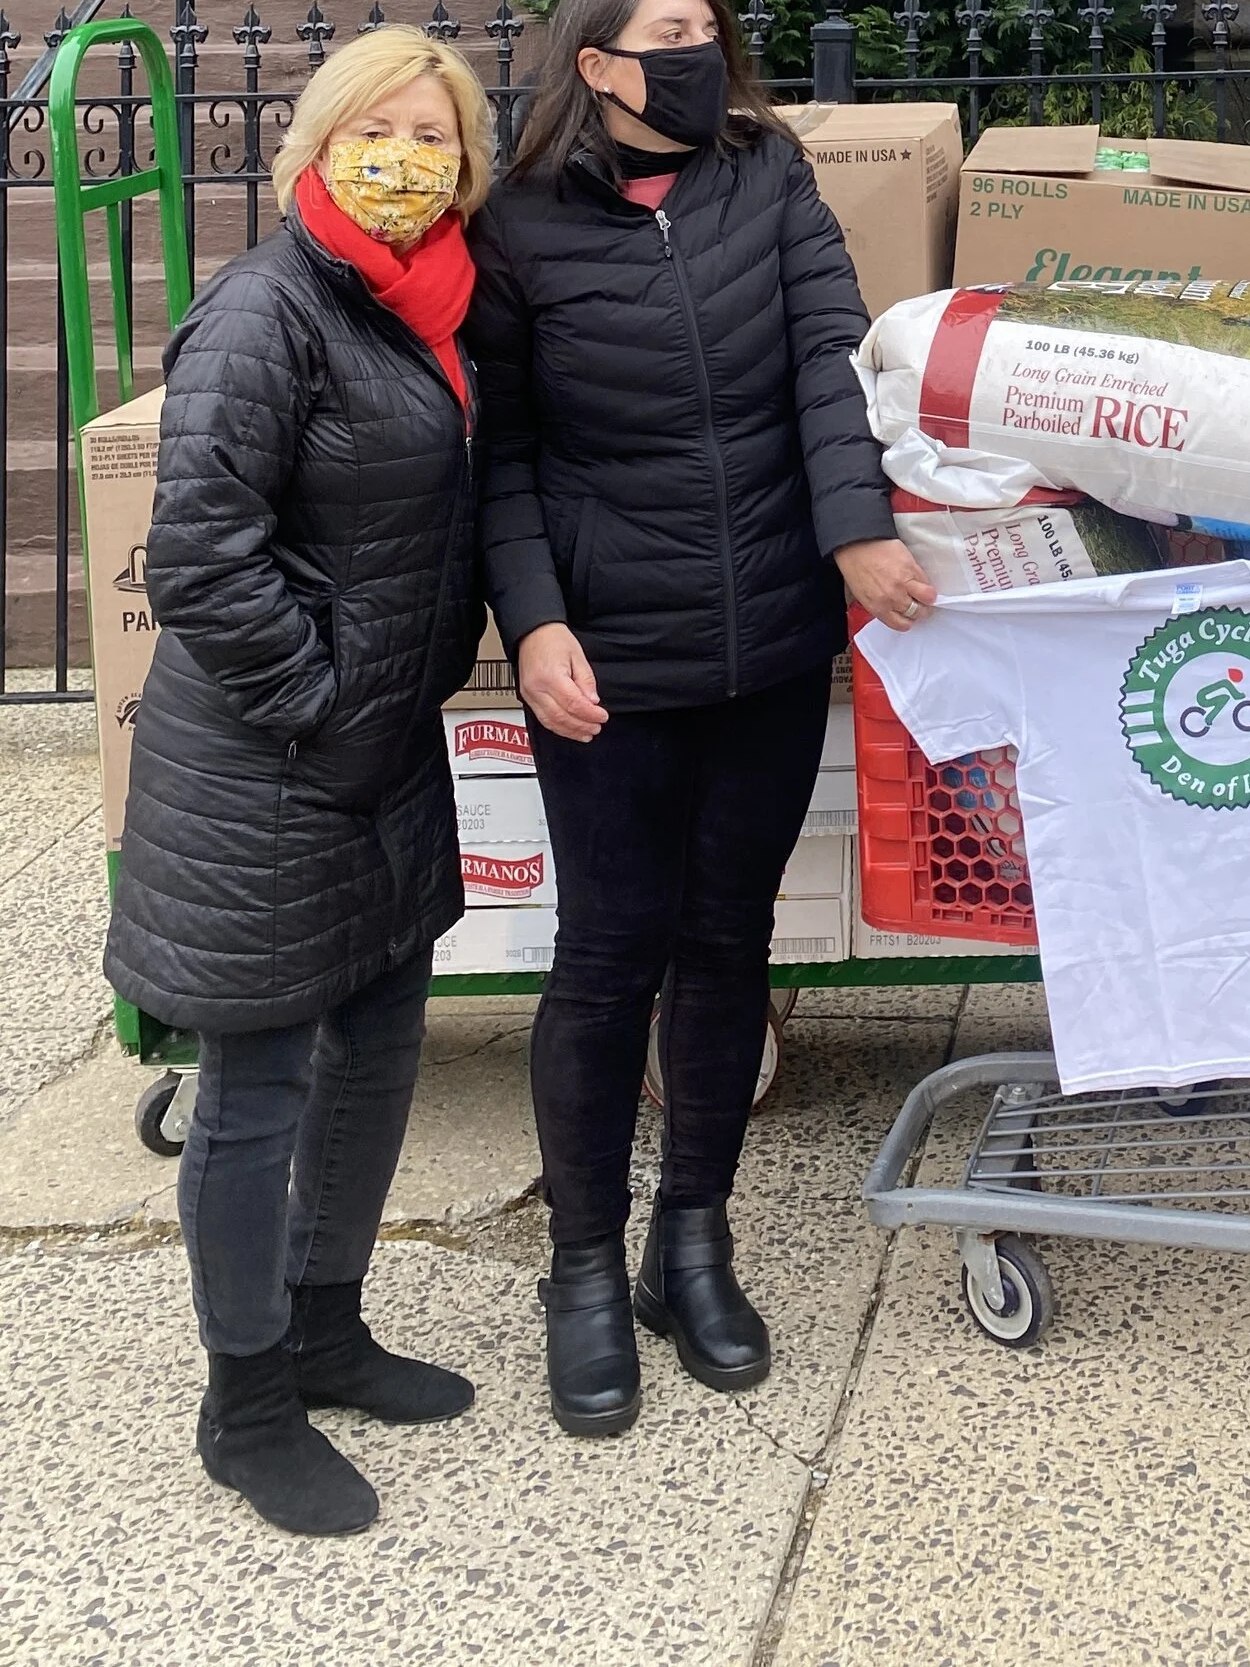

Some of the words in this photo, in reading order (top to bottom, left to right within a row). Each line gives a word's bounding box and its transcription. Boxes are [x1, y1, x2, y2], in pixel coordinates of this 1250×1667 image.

[817, 151, 852, 164] MADE
[855, 150, 868, 162] IN
[872, 149, 896, 162] USA
[972, 178, 996, 196] 96
[1001, 180, 1068, 200] ROLLS
[1123, 190, 1180, 209] MADE
[1187, 193, 1204, 210] IN
[970, 202, 981, 216] 2
[987, 203, 1024, 220] PLY
[1025, 340, 1050, 352] 100
[1054, 343, 1069, 354] LB
[1074, 346, 1115, 360] (45.36
[1118, 350, 1140, 364] kg)
[1012, 362, 1050, 385] Long
[1054, 366, 1095, 388] Grain
[1098, 371, 1169, 398] Enriched
[1005, 385, 1084, 415] Premium
[1001, 408, 1082, 438] Parboiled
[1089, 395, 1189, 452] RICE
[1005, 523, 1029, 559] Long
[1037, 515, 1054, 540] 100
[1048, 539, 1064, 558] LB
[1138, 631, 1196, 684] Tuga
[1160, 753, 1206, 794] Den
[1212, 778, 1239, 801] of
[456, 804, 491, 816] SAUCE
[870, 935, 900, 946] FRTS1
